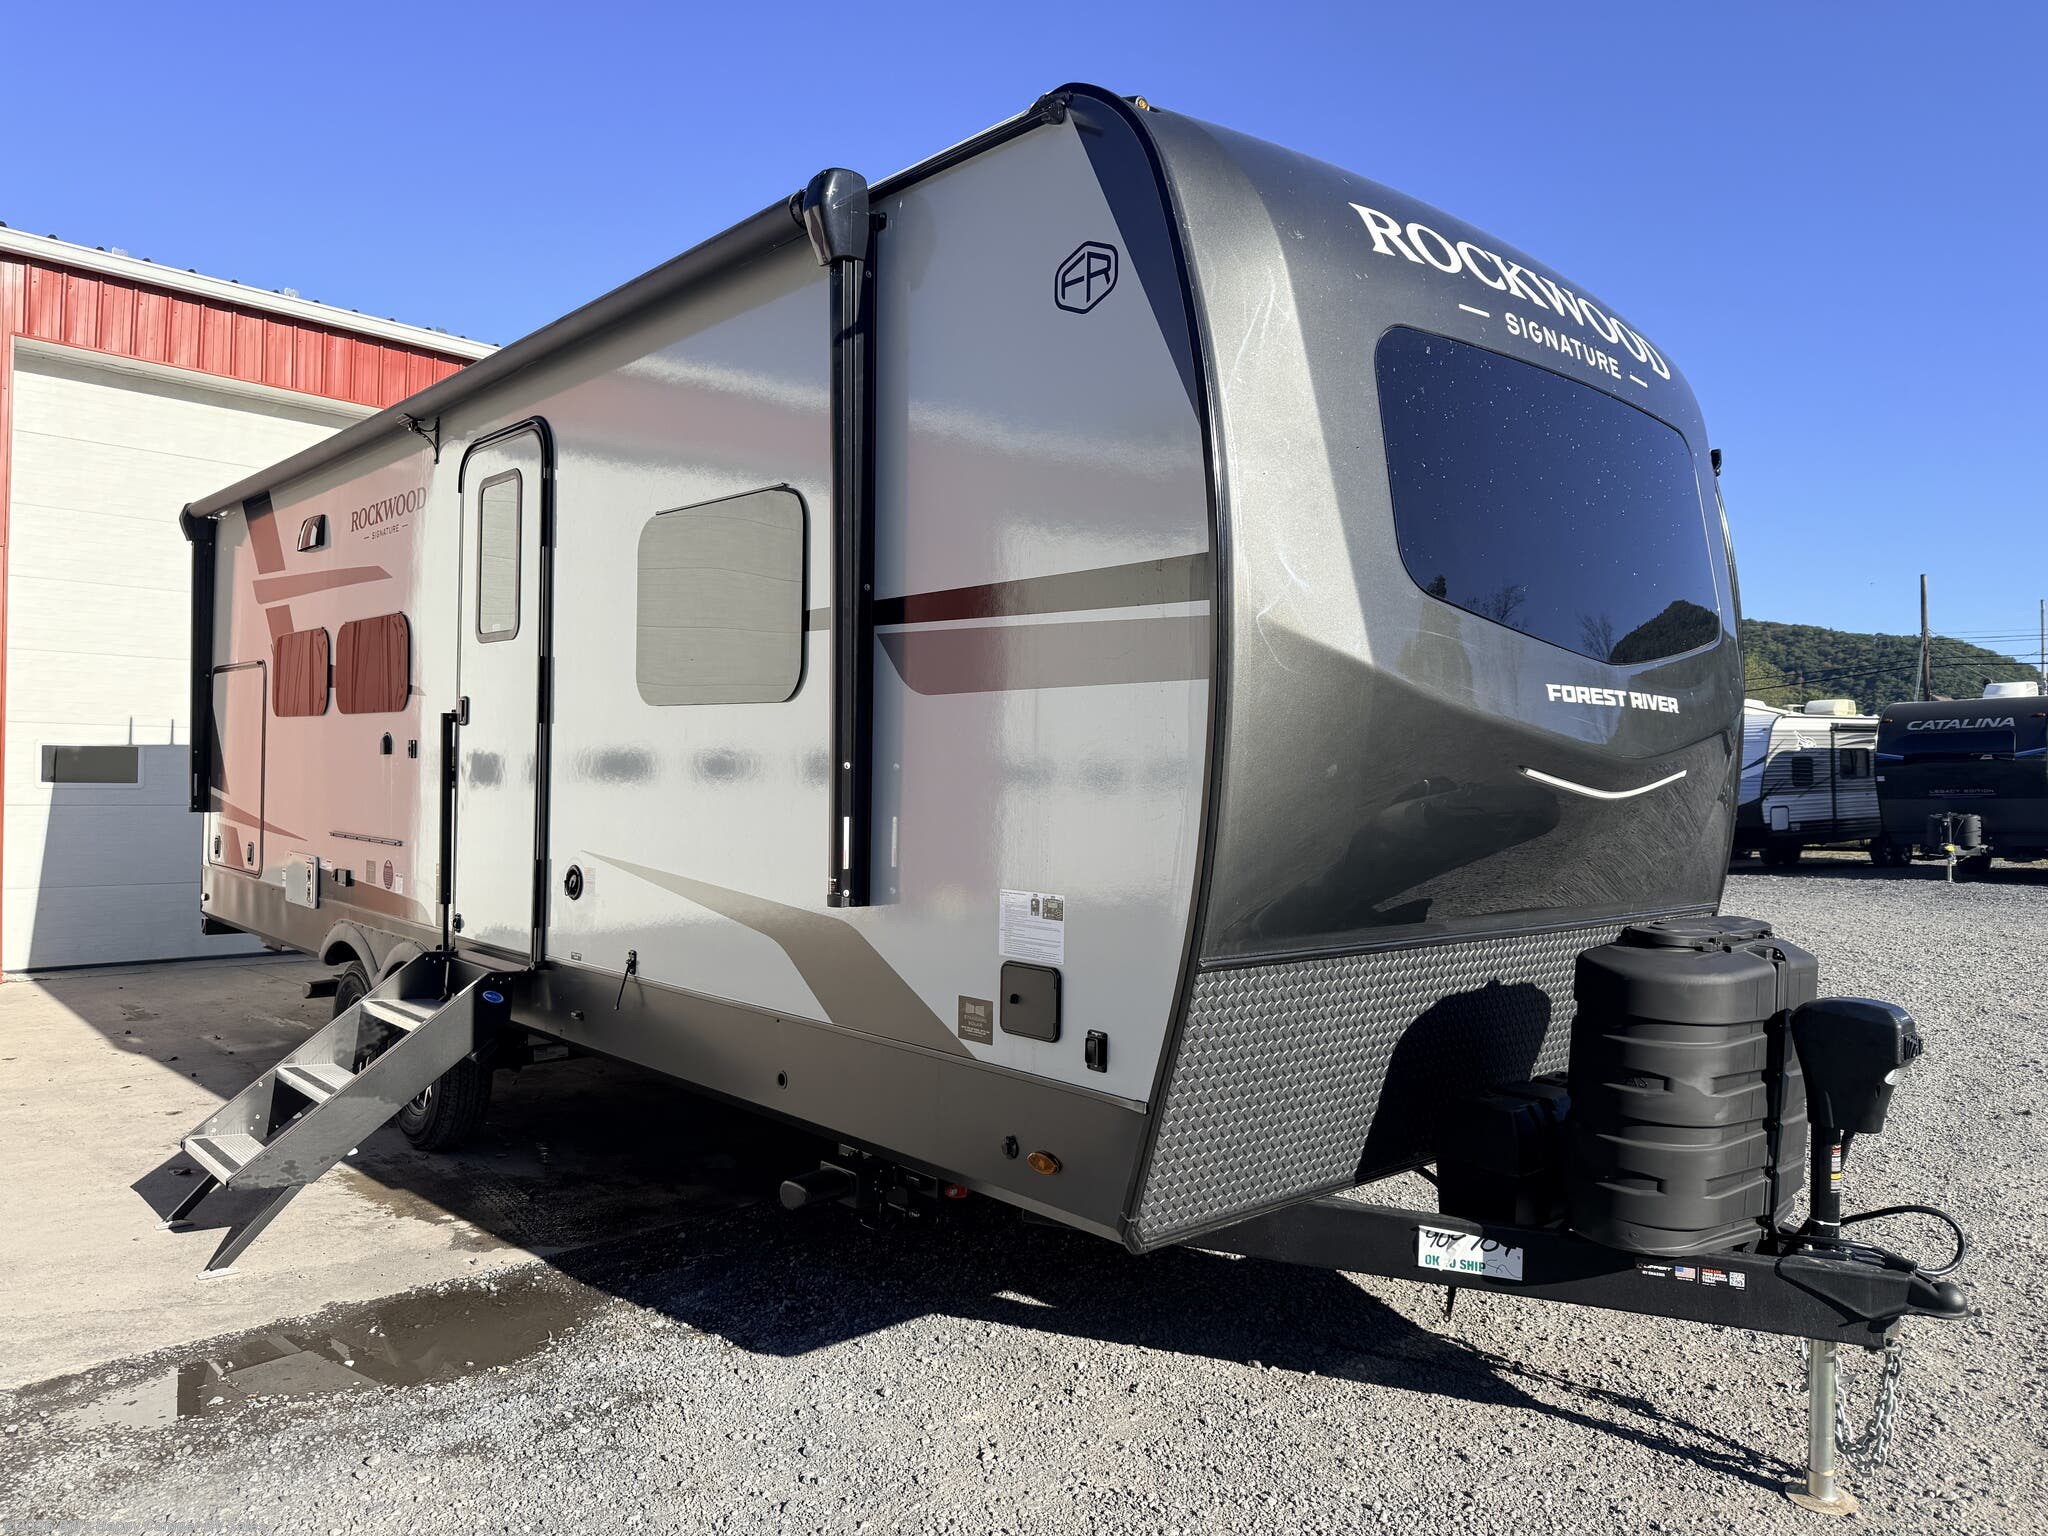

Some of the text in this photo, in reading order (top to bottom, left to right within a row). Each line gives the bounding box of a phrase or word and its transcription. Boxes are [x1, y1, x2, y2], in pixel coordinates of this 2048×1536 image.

[1348, 201, 1671, 381] ROCKWOOD
[1505, 312, 1622, 380] SIGNATURE
[351, 486, 427, 533] ROCKWOOD
[371, 523, 400, 540] SIGNATURE
[1545, 683, 1680, 714] FOREST RIVER
[1906, 717, 2016, 731] CATALINA
[1425, 1254, 1440, 1266] OK
[1459, 1259, 1487, 1273] SHIP
